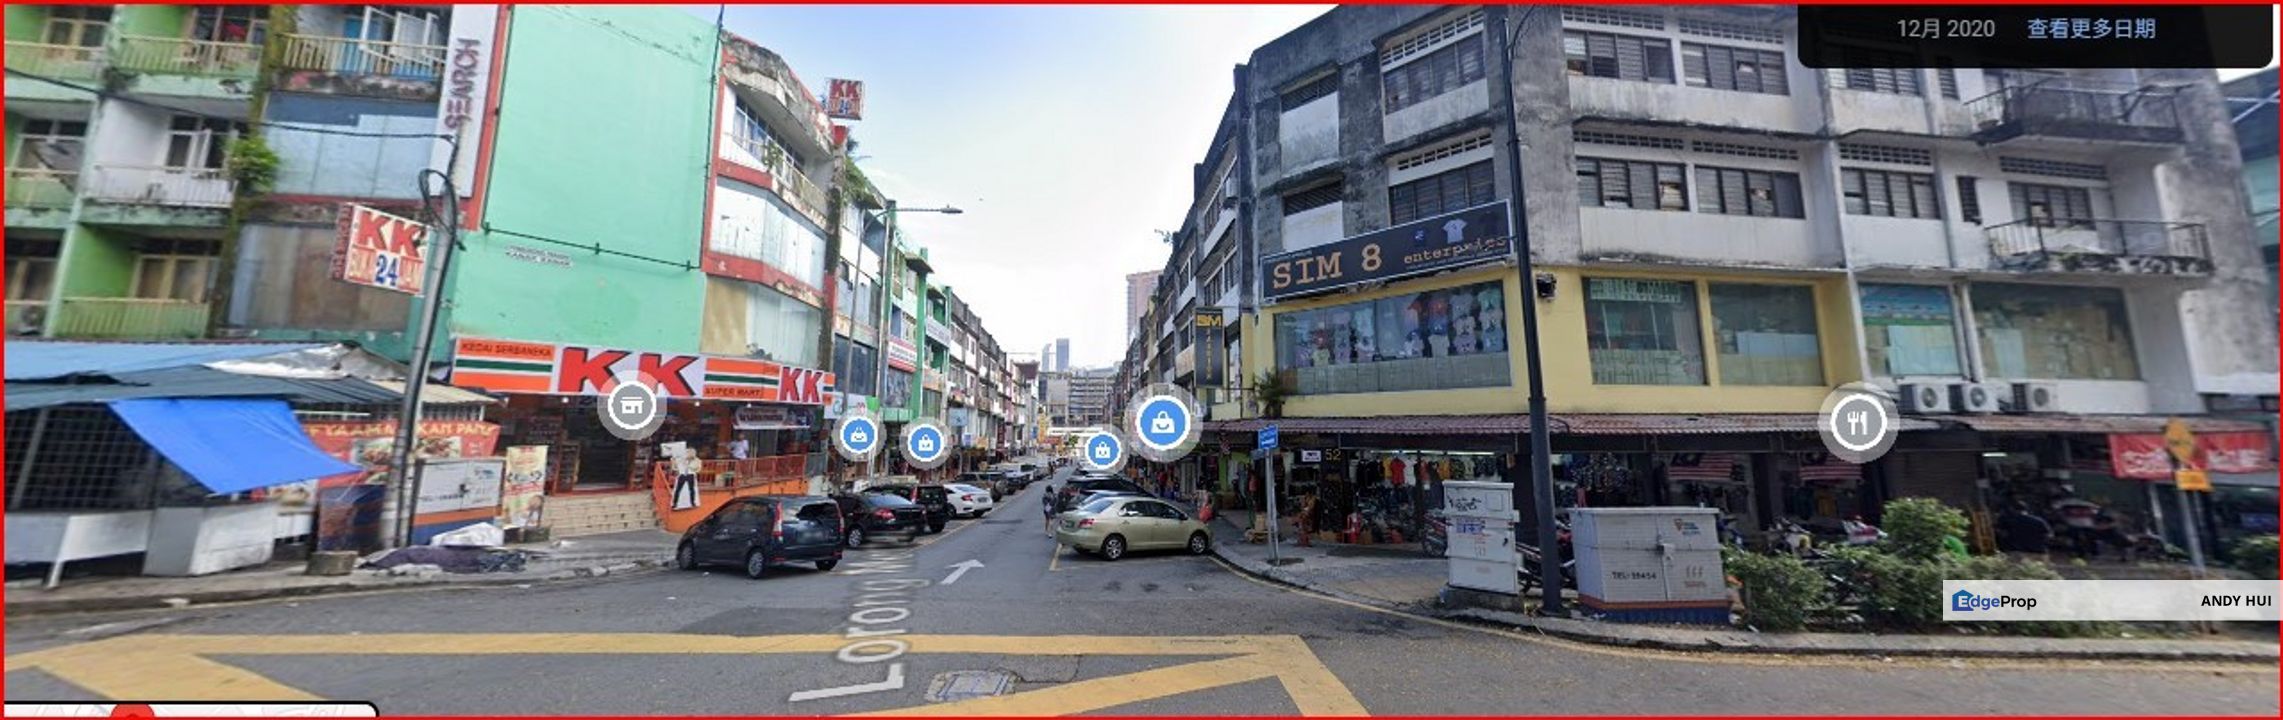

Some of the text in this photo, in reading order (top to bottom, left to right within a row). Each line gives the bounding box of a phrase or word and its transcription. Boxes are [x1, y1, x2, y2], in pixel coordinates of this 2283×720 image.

[444, 37, 481, 129] SEARCH
[830, 79, 860, 97] KK
[357, 210, 427, 258] KK
[374, 253, 399, 287] 24
[1273, 251, 1343, 289] SIM
[1361, 243, 1382, 272] 8
[704, 386, 761, 398] SUPER MART
[780, 366, 823, 403] KK
[1325, 448, 1341, 461] 52
[788, 579, 931, 701] Lorong
